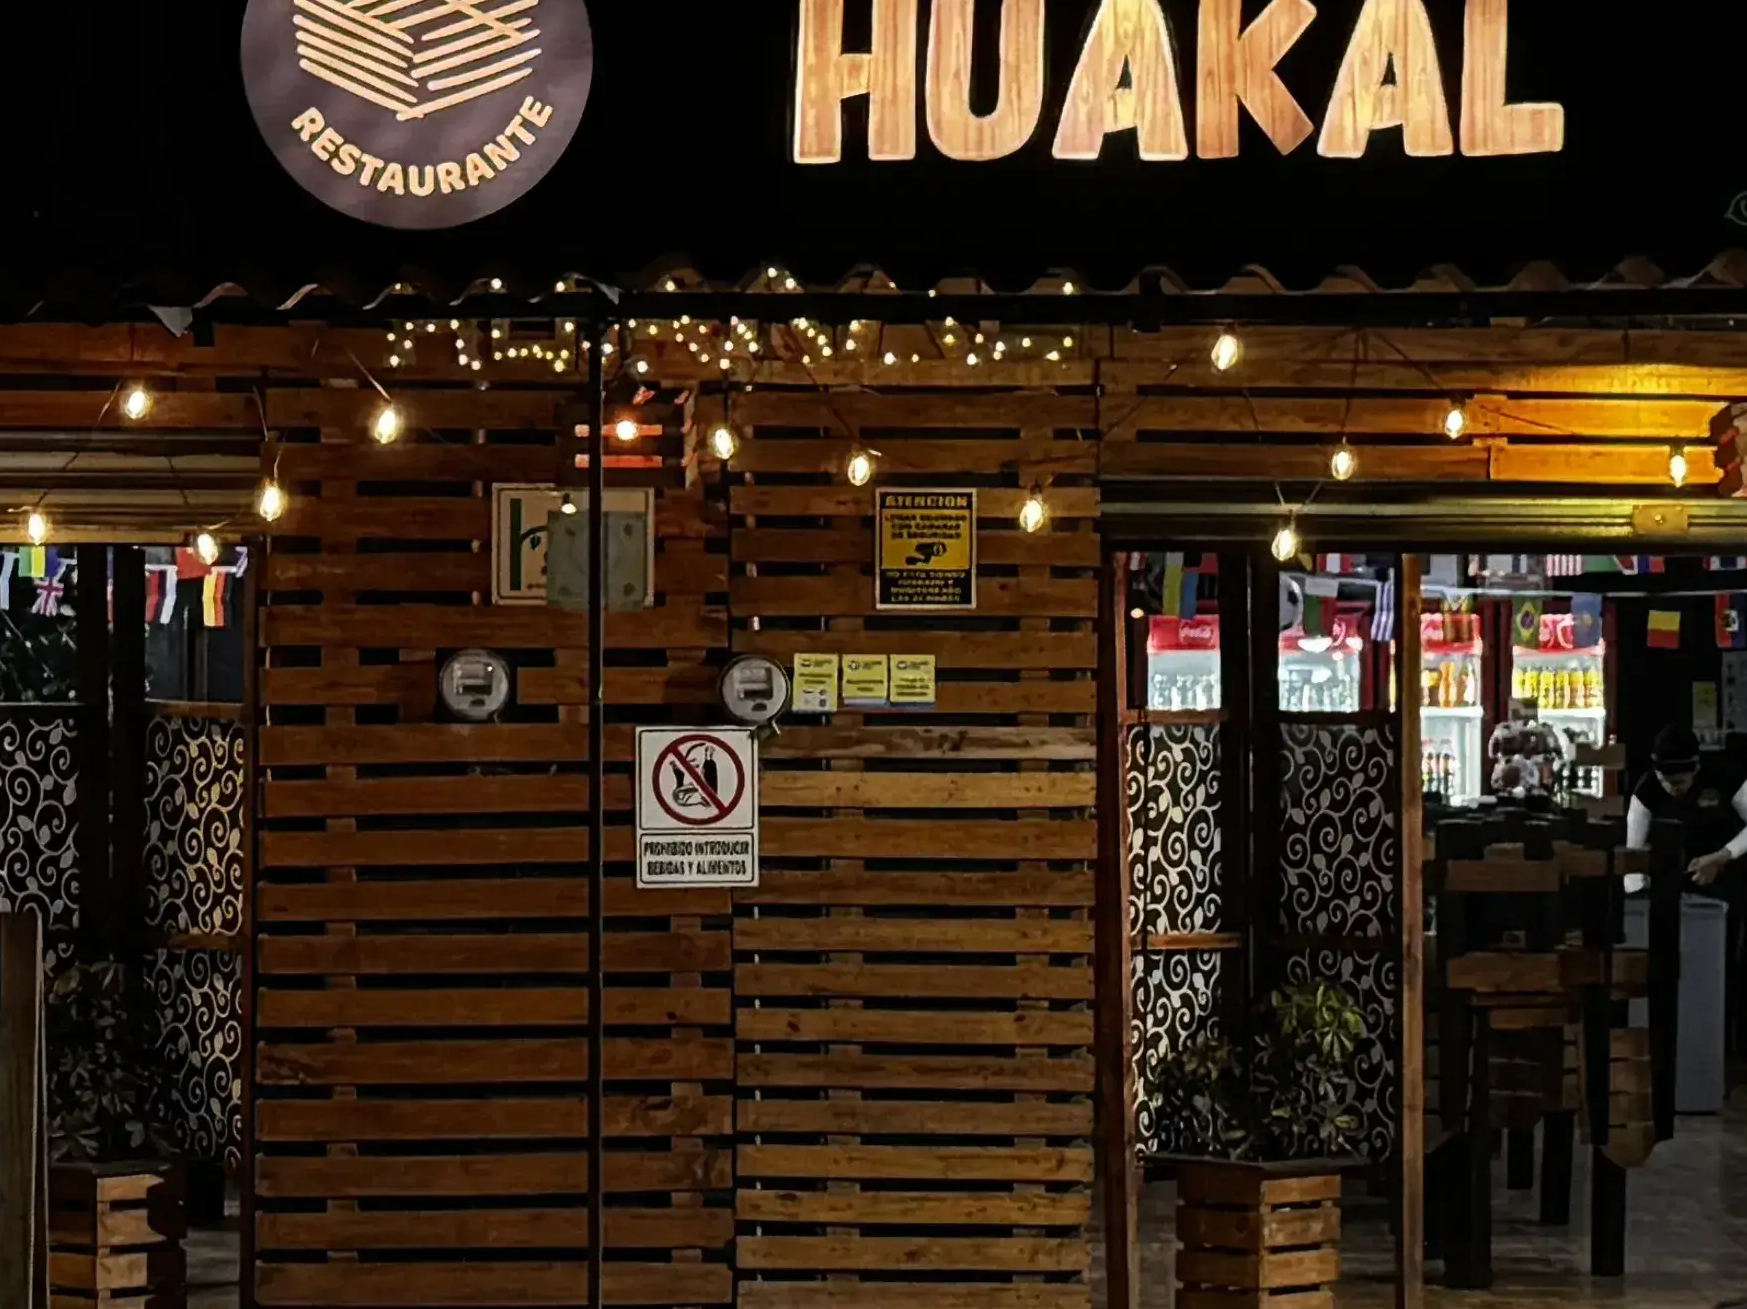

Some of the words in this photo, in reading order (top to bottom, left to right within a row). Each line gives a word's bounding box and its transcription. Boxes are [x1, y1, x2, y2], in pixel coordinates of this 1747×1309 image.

[291, 95, 553, 196] RESTAURANTE
[687, 861, 694, 875] Y
[696, 860, 747, 875] ALIMENTOS
